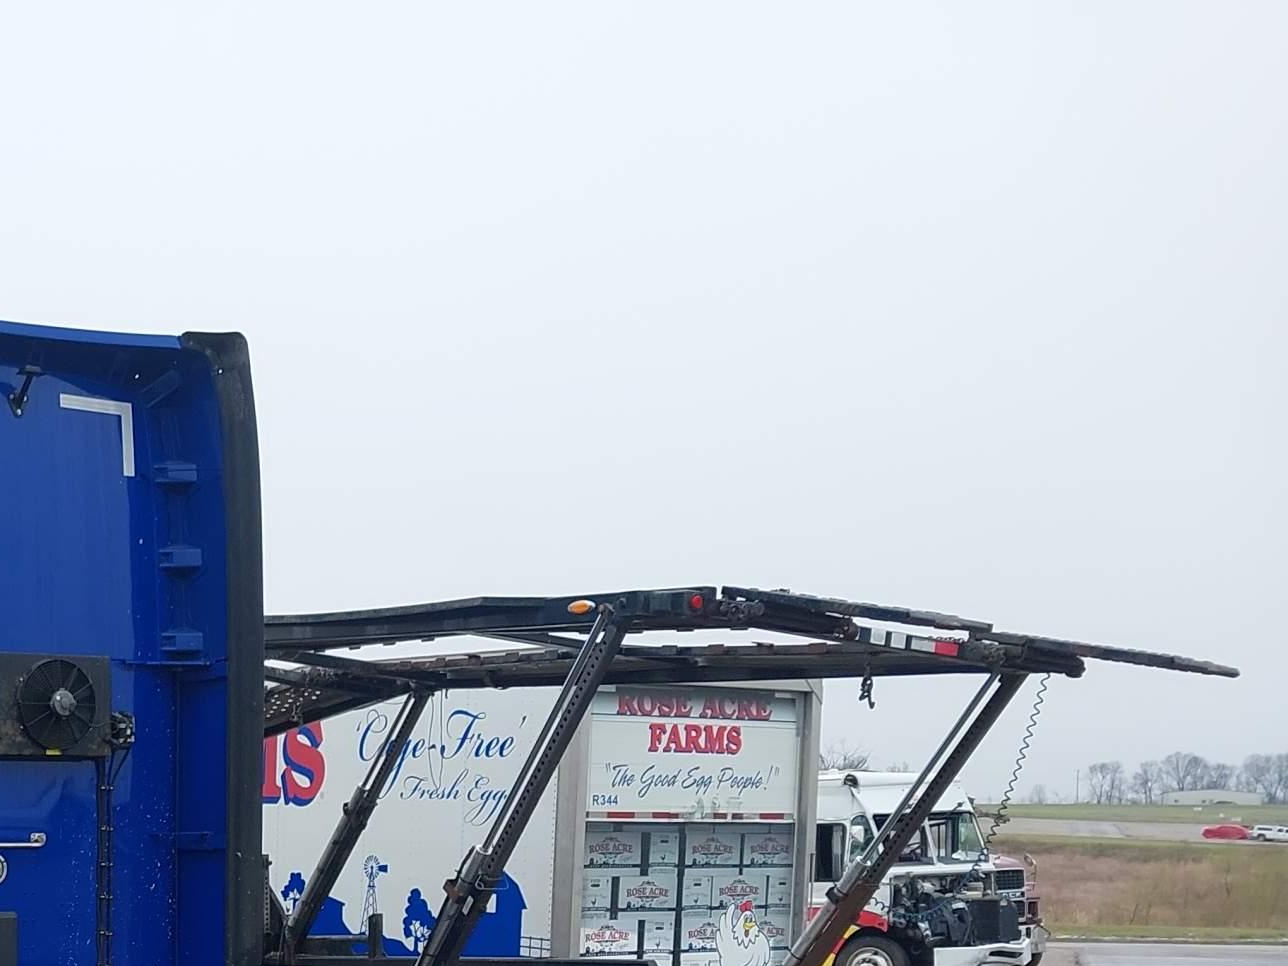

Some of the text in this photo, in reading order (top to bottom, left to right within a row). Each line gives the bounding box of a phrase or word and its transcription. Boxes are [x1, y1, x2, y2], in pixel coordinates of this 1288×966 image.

[617, 694, 772, 721] ROSE ACRE
[648, 722, 743, 755] FARMS
[638, 764, 682, 798] Good
[681, 766, 713, 796] Egg
[400, 768, 508, 827] Fresh Egg
[592, 794, 619, 806] R344
[589, 842, 633, 854] ROSE ACRE
[626, 888, 669, 898] ROSE ACRE
[719, 886, 760, 896] ROSE ACRE
[585, 931, 630, 943] ROSE ACRE
[688, 929, 710, 939] ROSE
